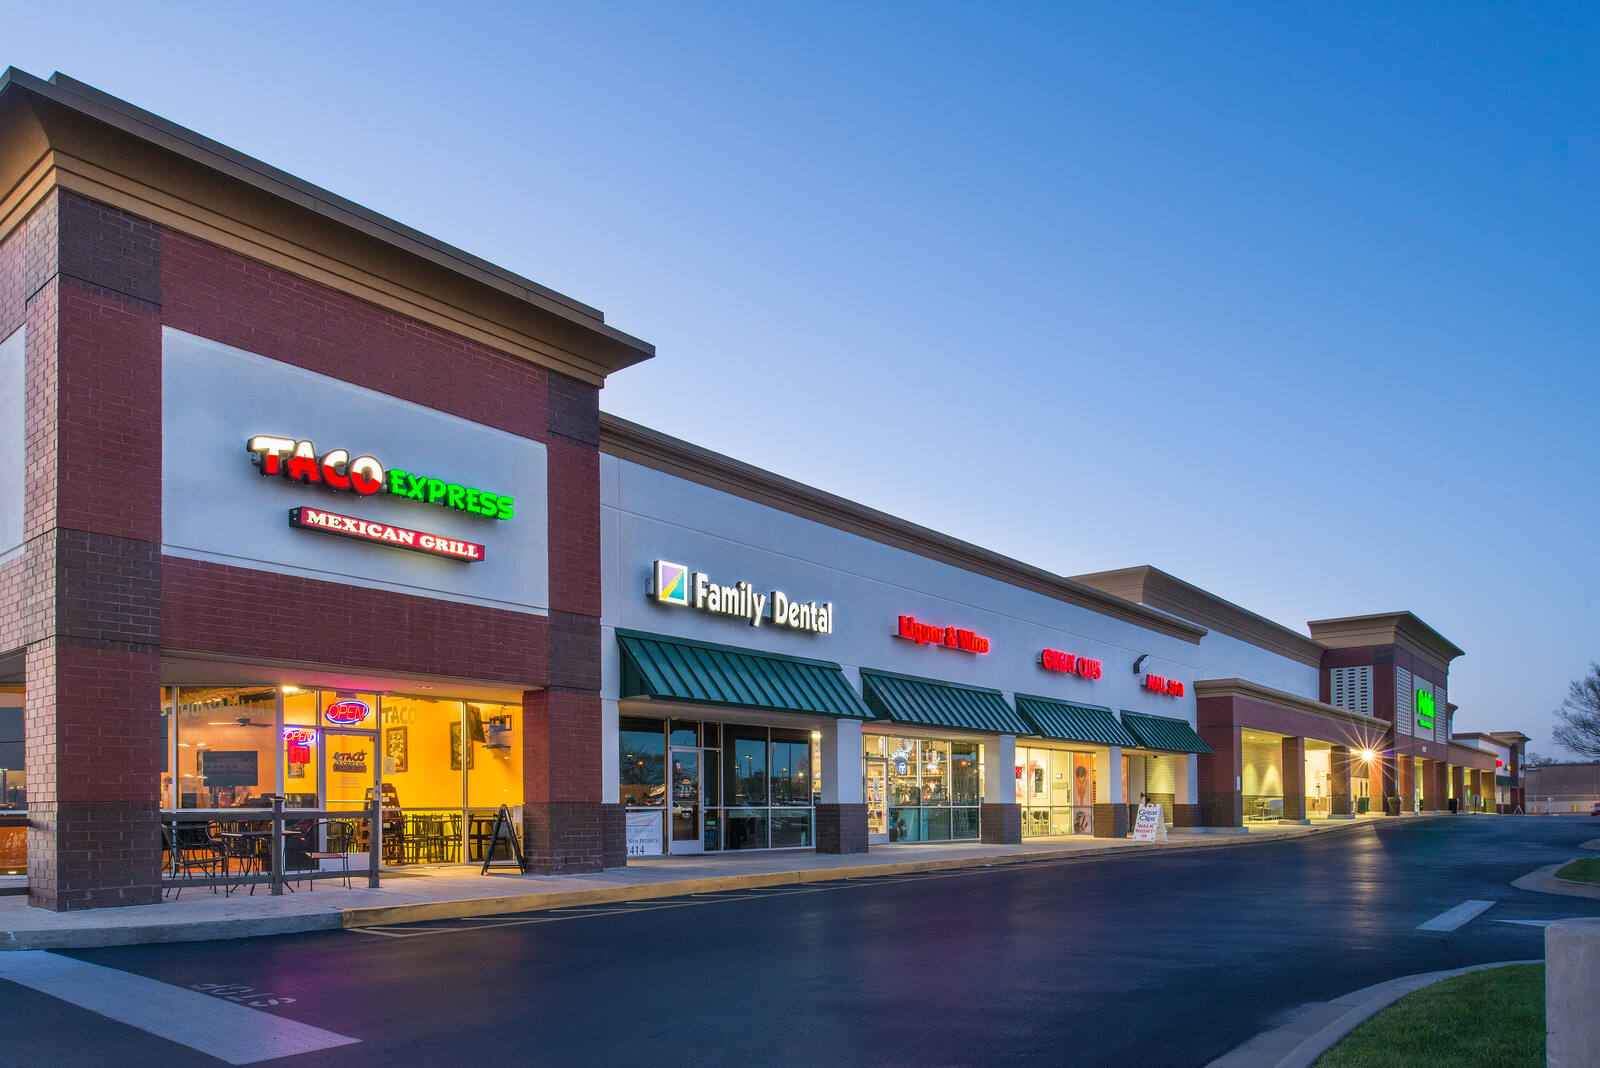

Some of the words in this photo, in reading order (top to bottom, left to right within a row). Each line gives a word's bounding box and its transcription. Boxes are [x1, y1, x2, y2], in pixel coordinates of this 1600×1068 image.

[247, 436, 385, 497] TACO
[388, 469, 514, 520] EXPRESS
[306, 511, 415, 545] MEXICAN
[419, 535, 479, 558] GRILL
[692, 572, 766, 628] Family
[771, 591, 833, 634] Dental
[898, 614, 945, 645] Liquor
[944, 626, 957, 648] &
[956, 628, 990, 653] Wine
[1041, 648, 1077, 675] GREAT
[1076, 656, 1103, 680] CLIPS
[1146, 673, 1168, 695] NAIL
[1167, 679, 1184, 697] SPA
[327, 702, 366, 721] OPEN
[284, 730, 314, 742] OPEN
